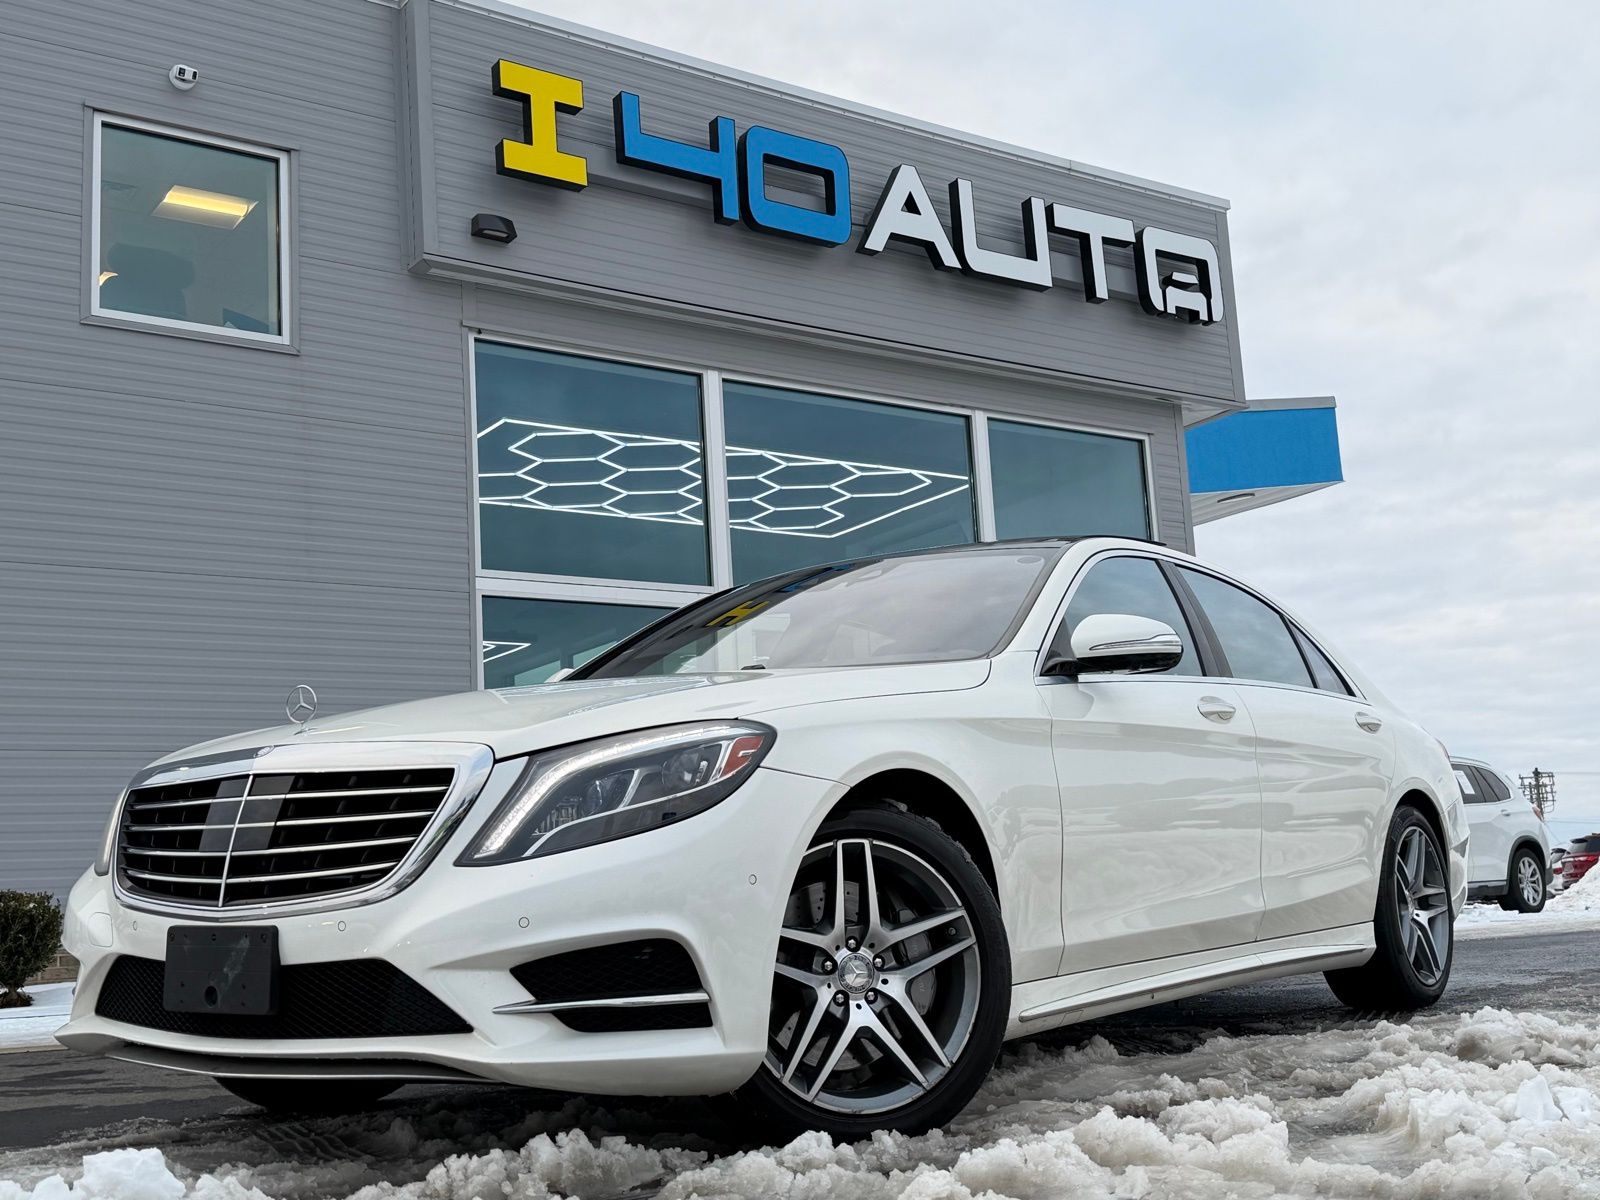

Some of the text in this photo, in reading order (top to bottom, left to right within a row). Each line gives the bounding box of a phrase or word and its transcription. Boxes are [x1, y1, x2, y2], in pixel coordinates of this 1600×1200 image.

[492, 59, 1224, 325] I 40 AUTO
